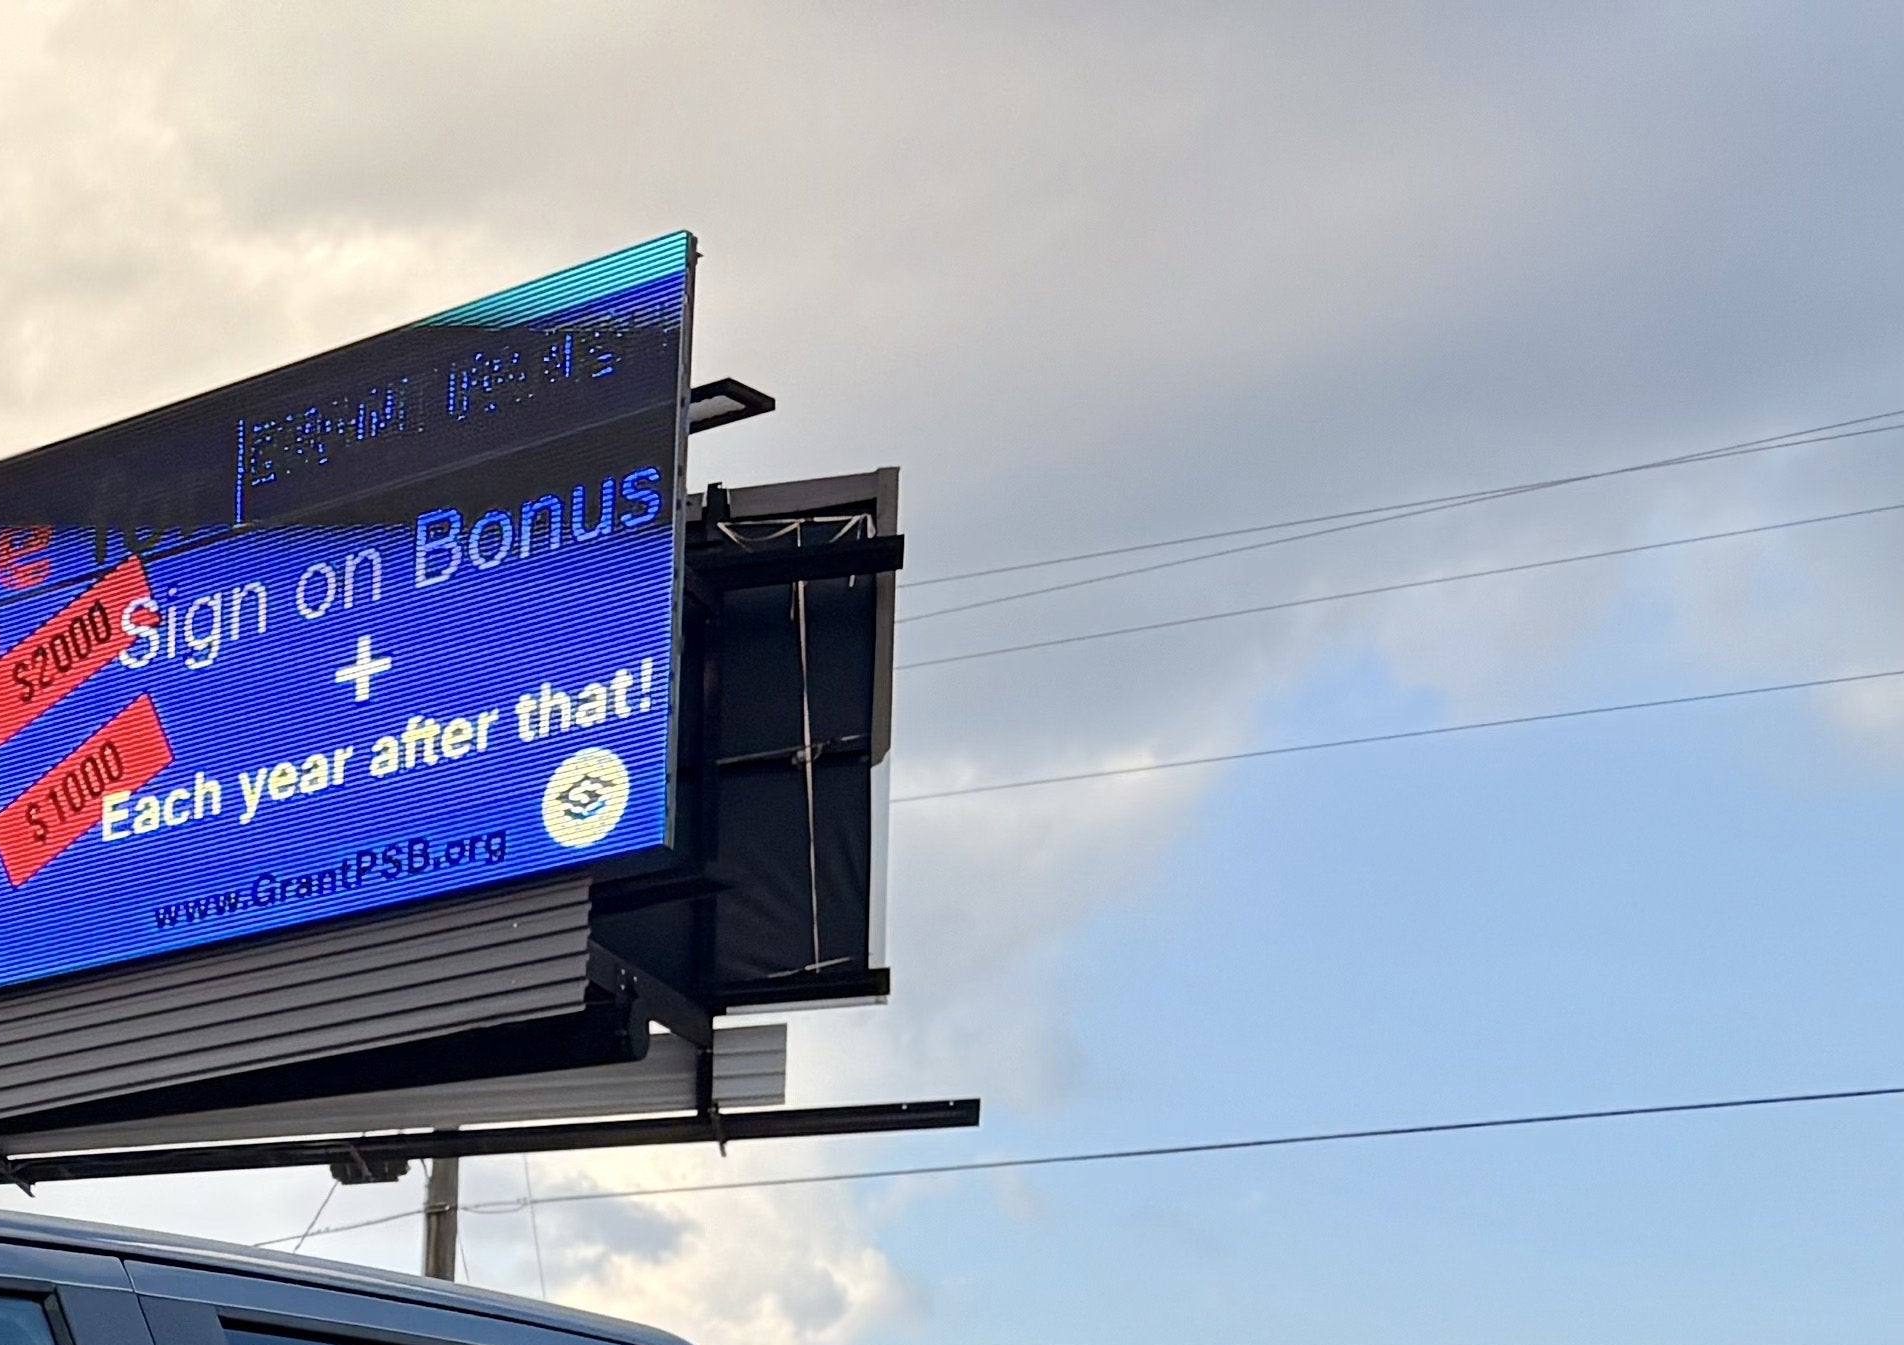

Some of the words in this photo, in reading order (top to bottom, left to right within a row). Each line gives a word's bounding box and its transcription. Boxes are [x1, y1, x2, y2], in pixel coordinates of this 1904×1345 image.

[118, 578, 268, 670] Sign
[295, 546, 383, 621] on
[415, 465, 662, 589] Bonus
[12, 600, 112, 704] $2000
[26, 741, 124, 844] $1000
[101, 771, 222, 843] Each
[238, 745, 355, 825] year
[369, 705, 500, 779] after
[515, 657, 654, 744] that!
[152, 828, 508, 931] www.GrantPSB.org
